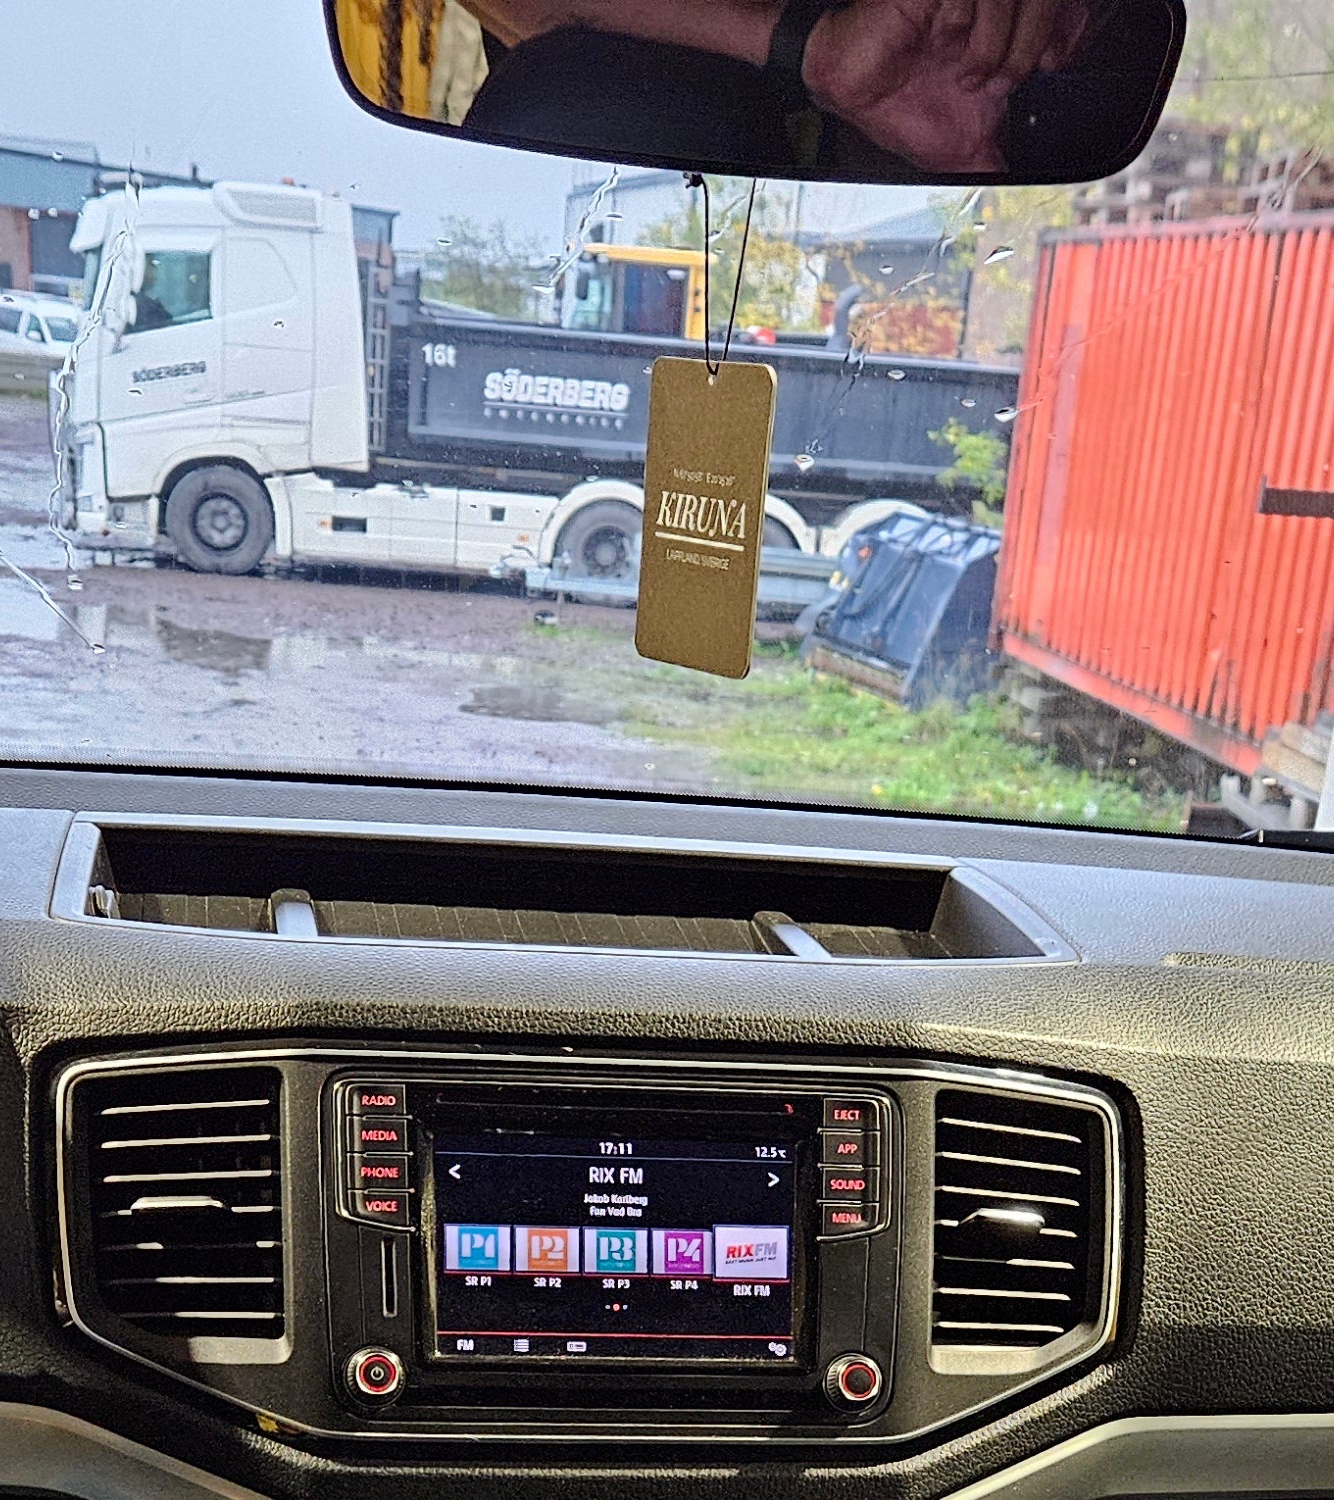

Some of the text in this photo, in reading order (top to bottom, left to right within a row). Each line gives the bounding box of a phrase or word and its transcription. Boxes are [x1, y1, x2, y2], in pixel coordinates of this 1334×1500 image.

[483, 367, 631, 411] SÖDERBERG
[655, 490, 747, 539] KIRUNA
[361, 1095, 396, 1106] RADIO
[834, 1109, 860, 1120] EJECT
[361, 1130, 398, 1141] MEDIA
[599, 1142, 633, 1155] 17:11
[837, 1143, 858, 1154] APP
[360, 1166, 399, 1178] PHONE
[589, 1166, 644, 1185] RIX FM
[830, 1179, 866, 1190] SOUND
[366, 1200, 398, 1212] VOICE
[832, 1213, 862, 1224] MENU
[461, 1233, 496, 1258] P1
[531, 1235, 565, 1259] P2
[599, 1236, 634, 1261] P3
[667, 1238, 702, 1262] P4
[465, 1275, 492, 1287] SR P1
[533, 1277, 562, 1288] SR P2
[602, 1278, 631, 1289] SR P3
[670, 1280, 699, 1290] SR P4
[733, 1284, 771, 1297] RIX FM
[456, 1338, 475, 1351] FM
